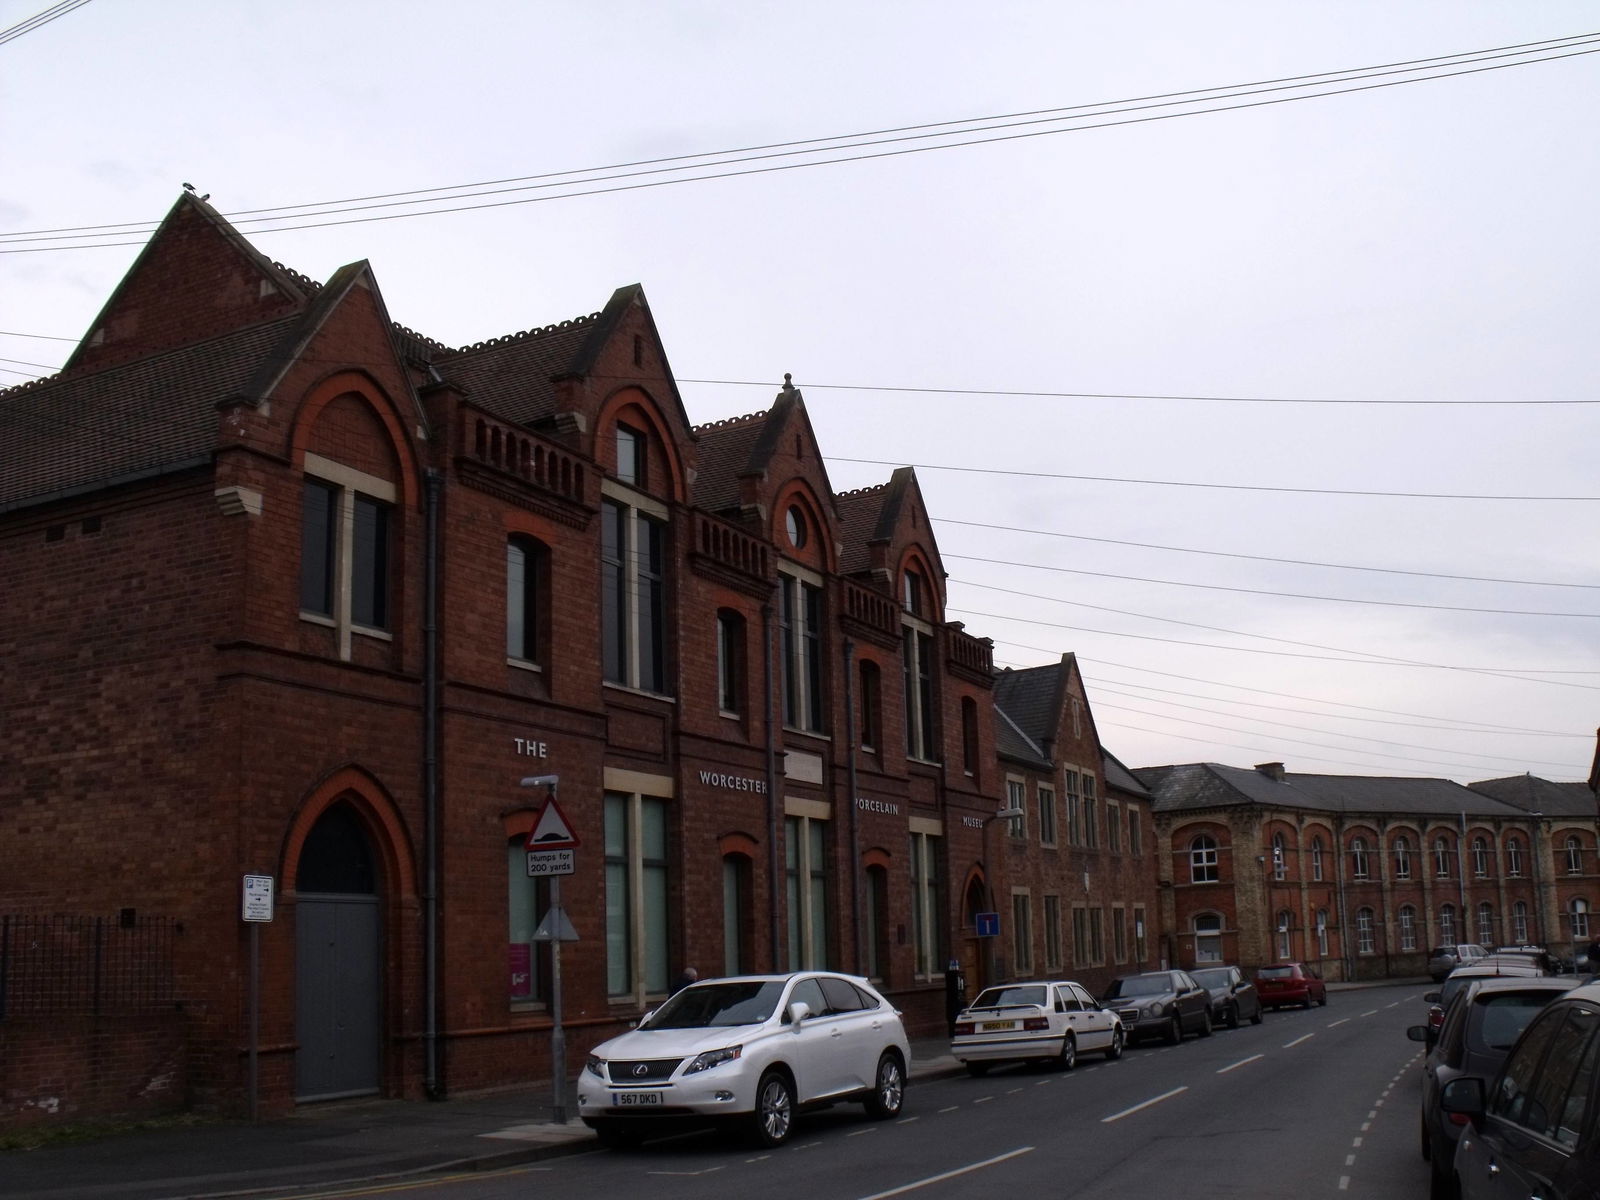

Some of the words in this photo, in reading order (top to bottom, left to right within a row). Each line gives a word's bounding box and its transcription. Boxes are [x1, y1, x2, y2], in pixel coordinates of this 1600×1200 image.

[514, 738, 547, 758] THE
[699, 770, 768, 794] WORCESTER
[962, 816, 983, 829] MUSEU
[530, 854, 556, 863] Humps
[531, 863, 547, 872] 200
[550, 863, 571, 872] yards
[621, 1094, 637, 1104] 567
[639, 1094, 657, 1104] DKD
